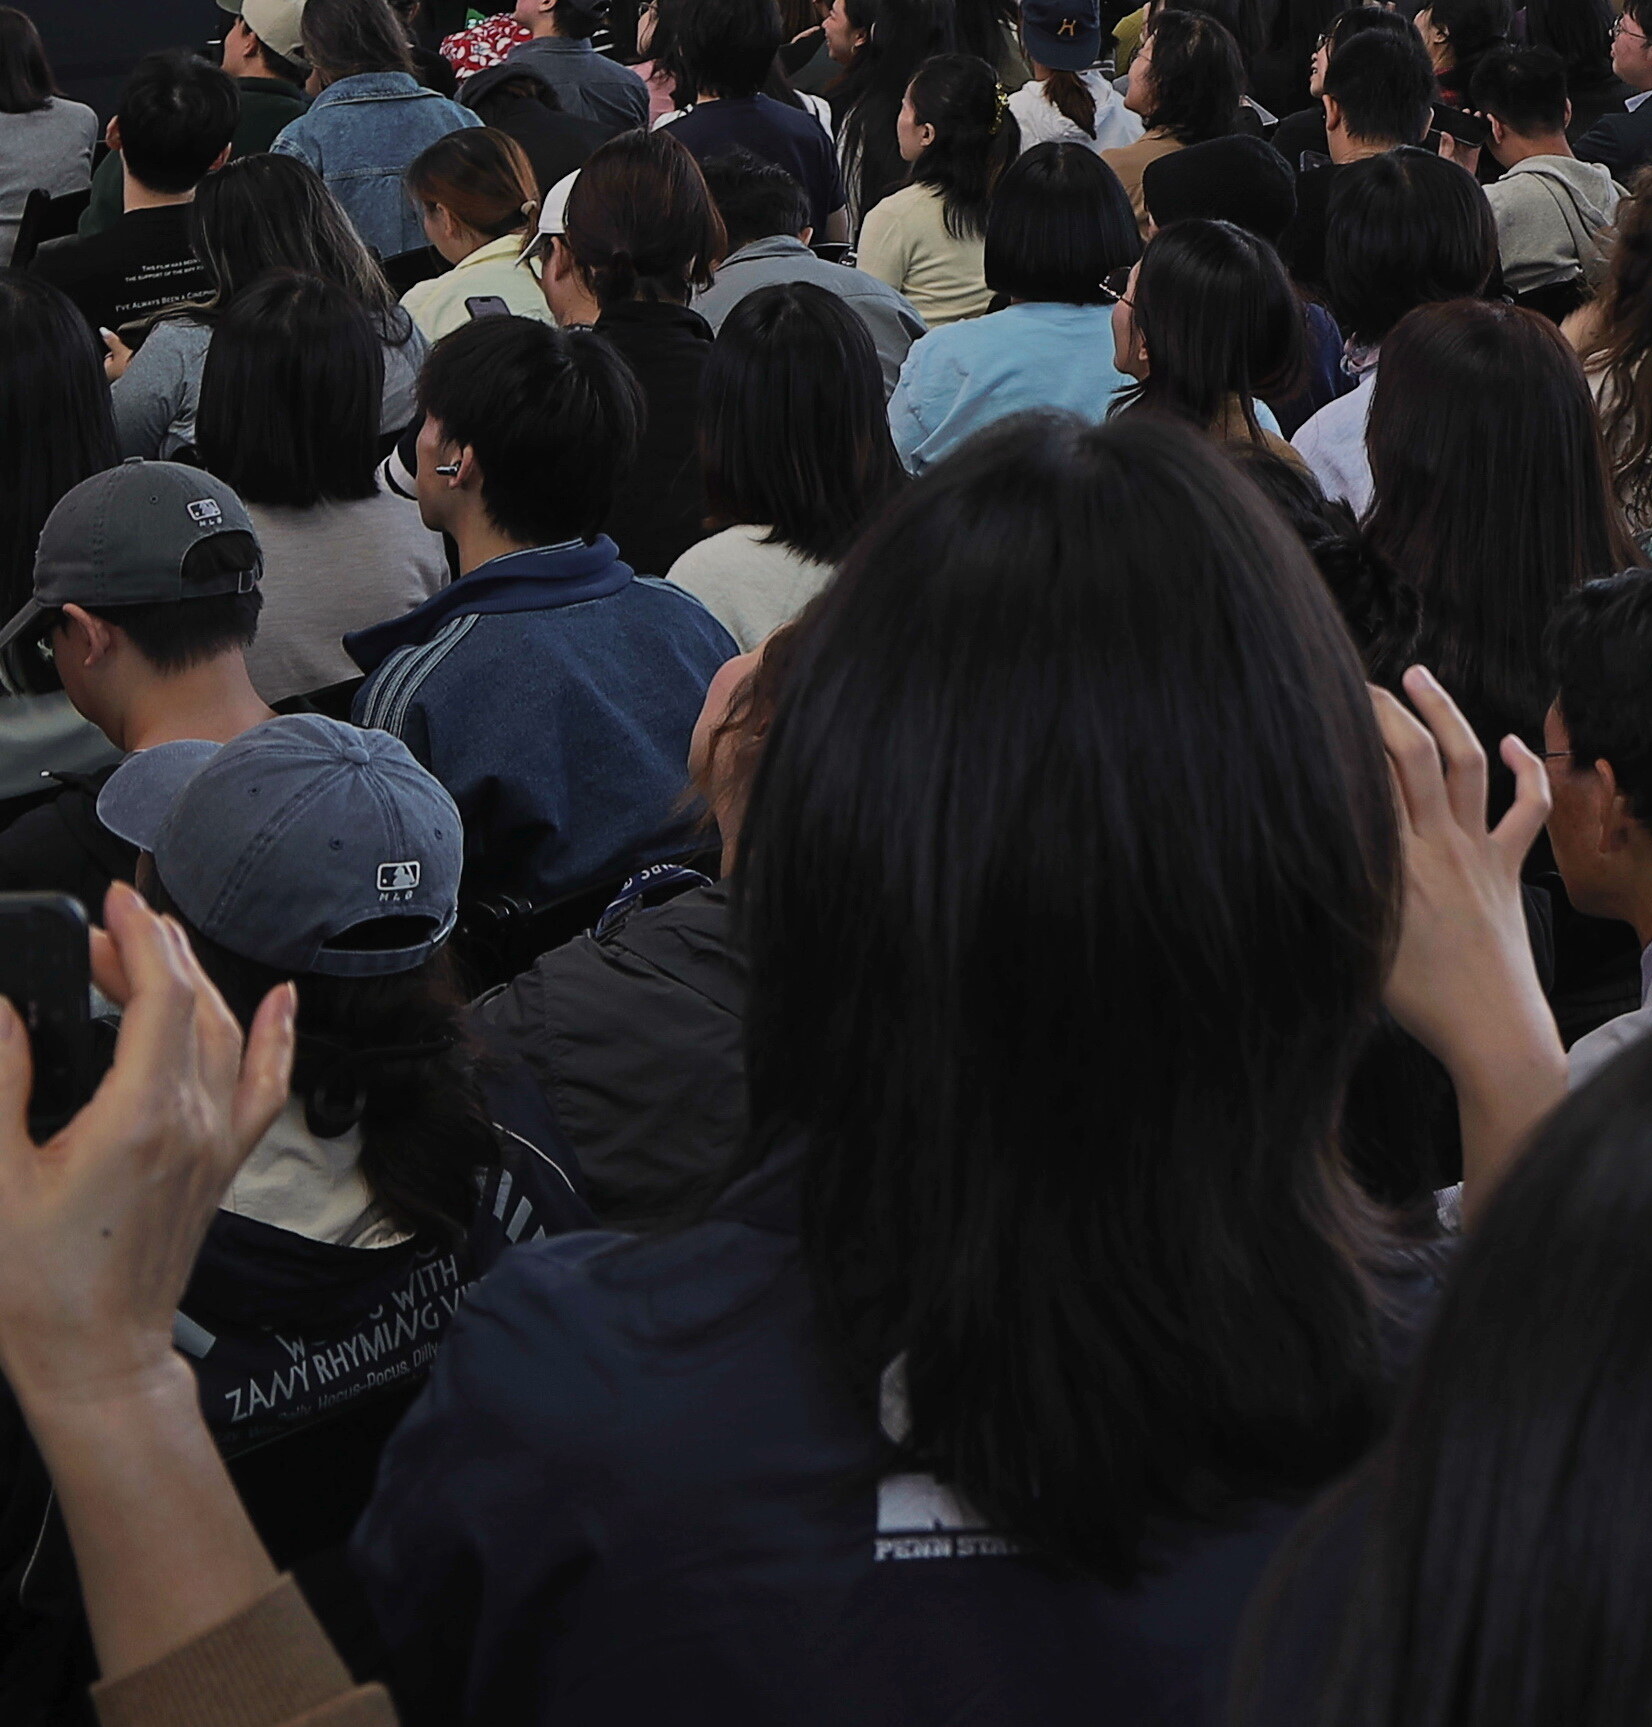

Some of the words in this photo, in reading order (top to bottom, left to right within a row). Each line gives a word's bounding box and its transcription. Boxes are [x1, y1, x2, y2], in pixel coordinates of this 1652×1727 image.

[390, 1253, 459, 1312] WITH
[225, 1358, 310, 1422] ZANY
[312, 1302, 440, 1385] RHYMING
